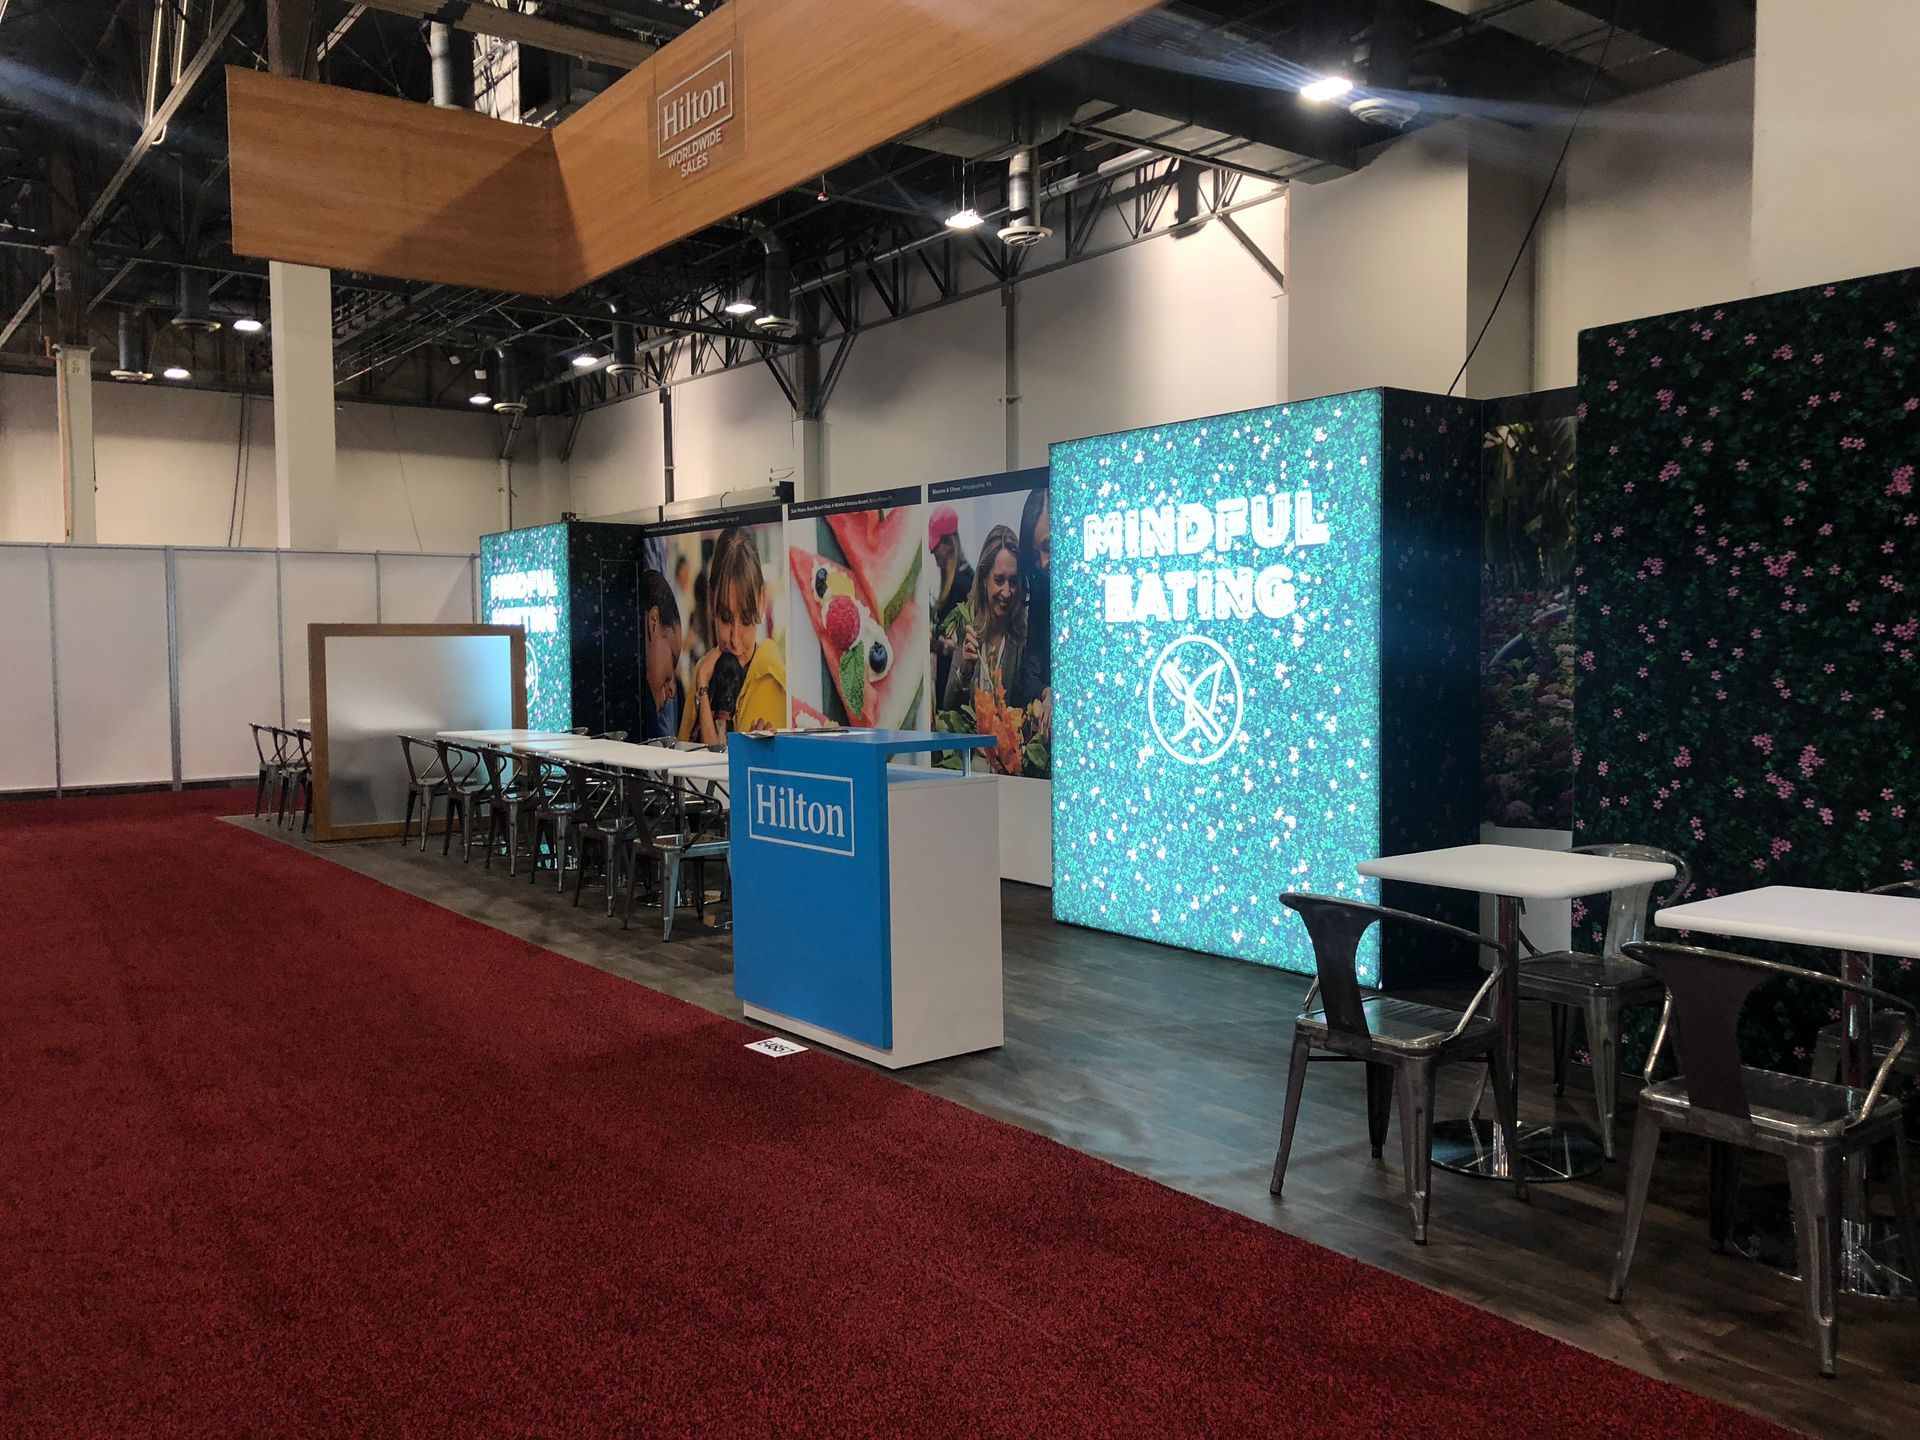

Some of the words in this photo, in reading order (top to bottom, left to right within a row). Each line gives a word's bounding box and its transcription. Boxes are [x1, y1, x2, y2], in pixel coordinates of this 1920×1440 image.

[663, 80, 727, 142] Hilton
[668, 128, 722, 168] WORLDWIDE
[681, 152, 708, 178] SALES
[1083, 490, 1331, 562] MINDFUL
[1105, 564, 1297, 622] EATING
[756, 784, 845, 838] Hilton
